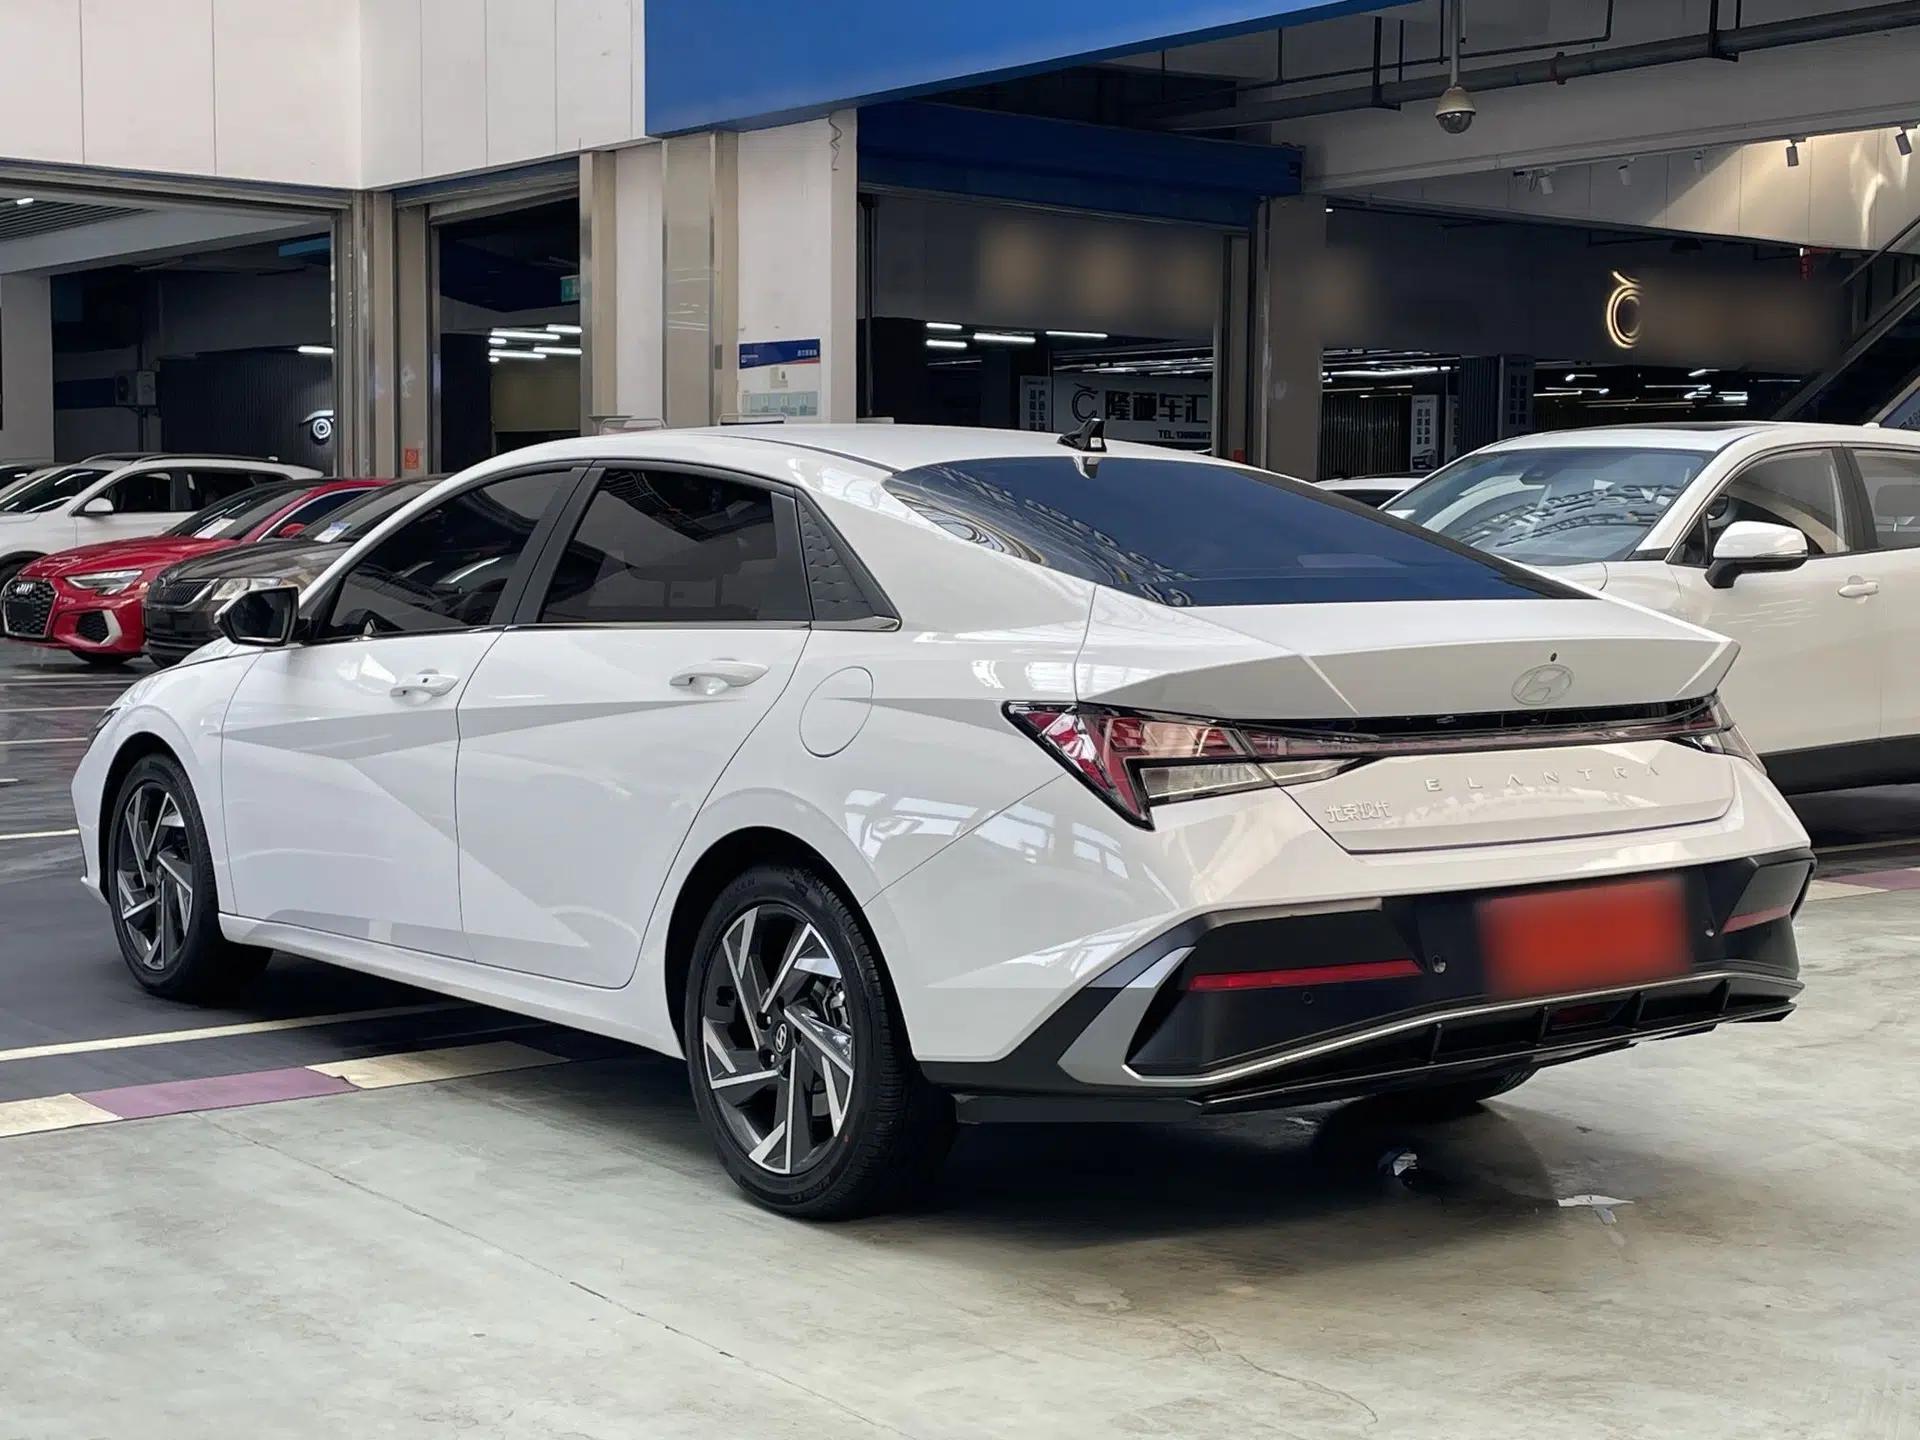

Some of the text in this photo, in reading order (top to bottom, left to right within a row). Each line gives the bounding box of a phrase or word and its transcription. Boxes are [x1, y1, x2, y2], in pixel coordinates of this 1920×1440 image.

[1424, 765, 1660, 792] ELANTRA
[1325, 799, 1392, 823] 北京现代
